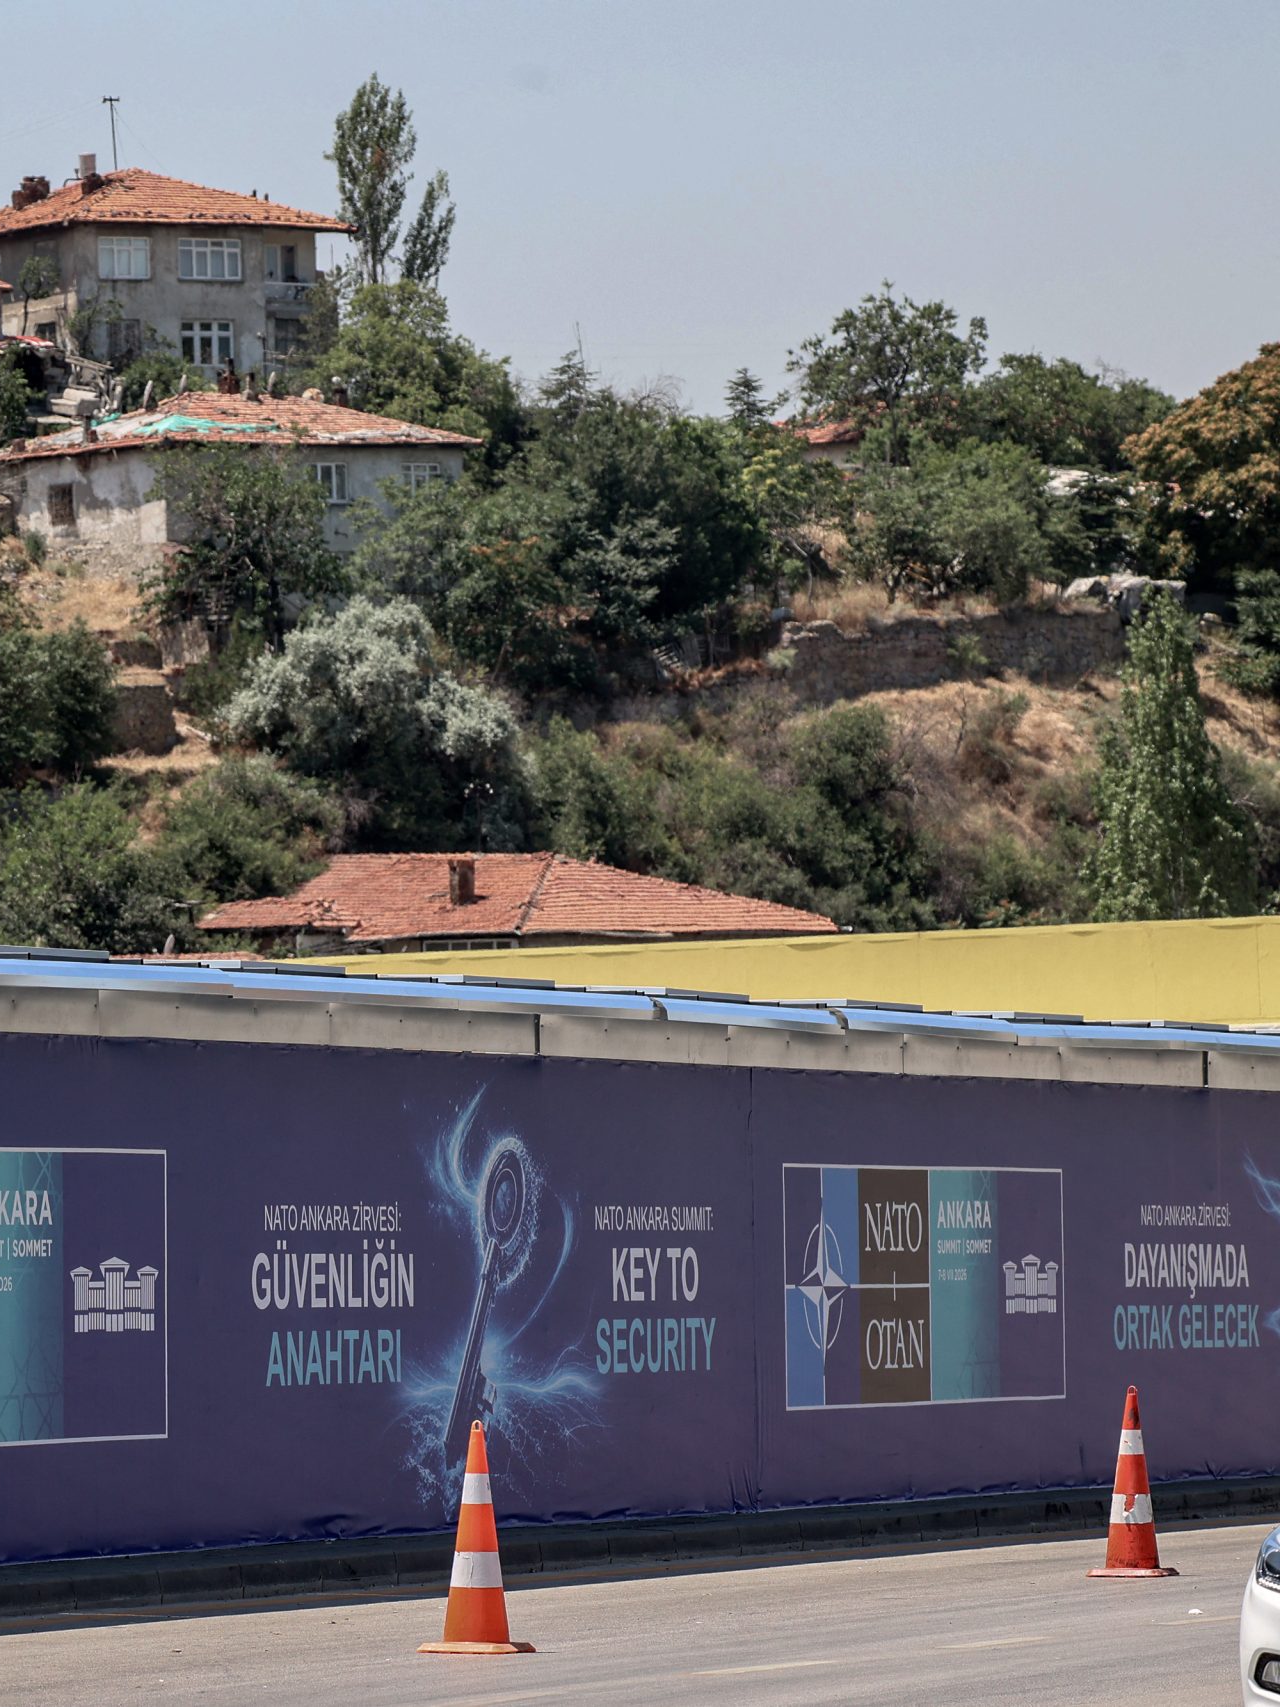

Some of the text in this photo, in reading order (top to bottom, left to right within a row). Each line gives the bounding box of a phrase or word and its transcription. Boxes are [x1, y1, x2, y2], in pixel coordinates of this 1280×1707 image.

[264, 1201, 402, 1232] NATO ANKARA ZİRVESİ:
[595, 1206, 714, 1231] NATO ANKARA SUMMIT:
[864, 1202, 923, 1252] NATO
[937, 1200, 992, 1229] ANKARA
[1141, 1203, 1231, 1227] NATO ANKARA ZİRVESİ:
[12, 1239, 53, 1257] SOMMET
[937, 1240, 961, 1254] SUMMIT
[966, 1240, 992, 1254] SOMMET
[1124, 1243, 1250, 1299] DAYANIŞMADA
[251, 1238, 415, 1310] GÜVENLİĞİN
[612, 1246, 699, 1302] KEY TO
[596, 1317, 716, 1375] SECURITY
[866, 1318, 924, 1370] OTAN
[1114, 1304, 1260, 1350] ORTAK GELECEK
[265, 1329, 402, 1387] ANAHTARI
